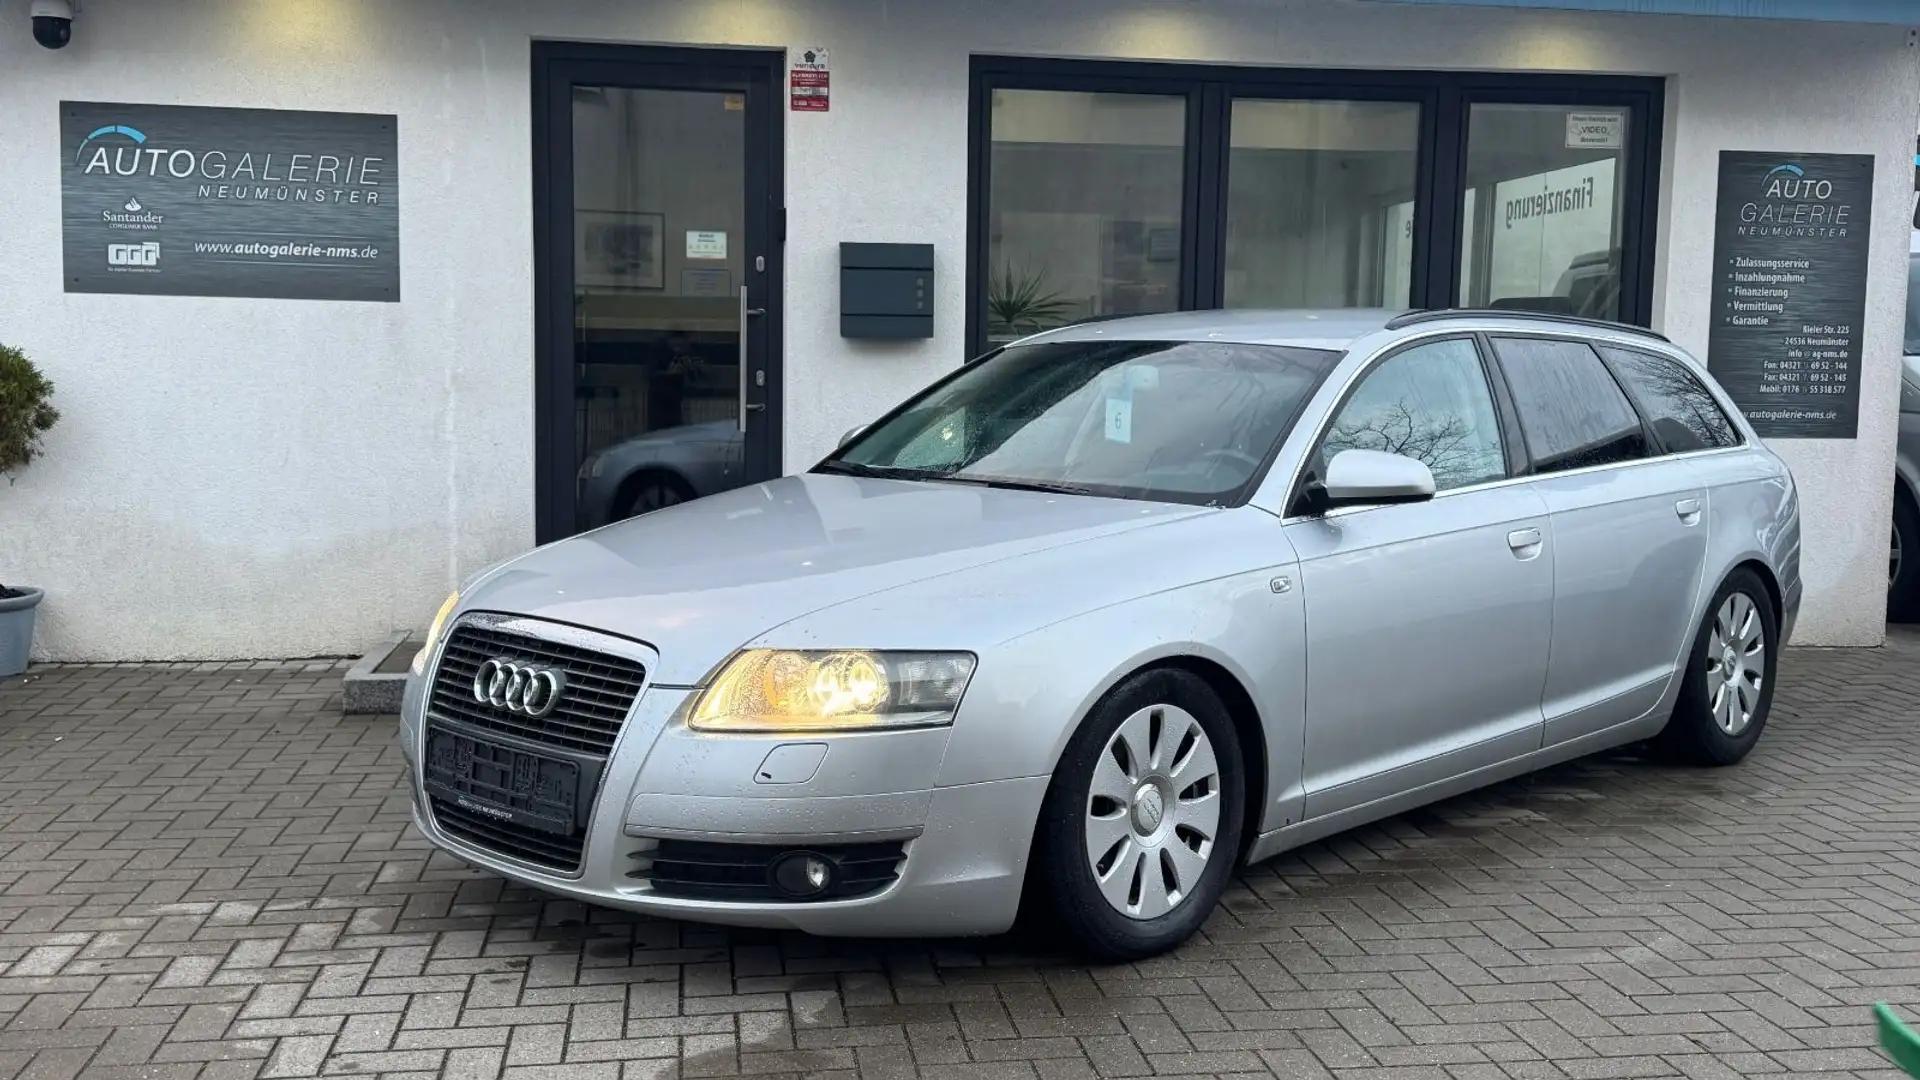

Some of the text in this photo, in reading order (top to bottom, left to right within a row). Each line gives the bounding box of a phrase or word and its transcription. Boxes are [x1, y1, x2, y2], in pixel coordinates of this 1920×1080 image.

[84, 147, 383, 185] AUTOGALERIE
[198, 184, 379, 204] NEUMÜNSTER
[1765, 179, 1832, 199] AUTO
[103, 210, 164, 223] Santander
[1740, 202, 1851, 225] GALERIE
[1737, 225, 1847, 237] NEUMÜNSTER
[194, 240, 379, 260] www.autogalerie-nms.de
[1735, 257, 1810, 270] Zulassungsservice
[1735, 271, 1806, 284] Inzahlungnahme
[1734, 286, 1789, 299] Finanzierung
[1733, 300, 1783, 313] Vermittlung
[1732, 315, 1769, 325] Garantie
[1802, 325, 1850, 334] Kieler Str. 225
[1807, 337, 1849, 346] Neumünster
[1763, 372, 1779, 381] Fax:
